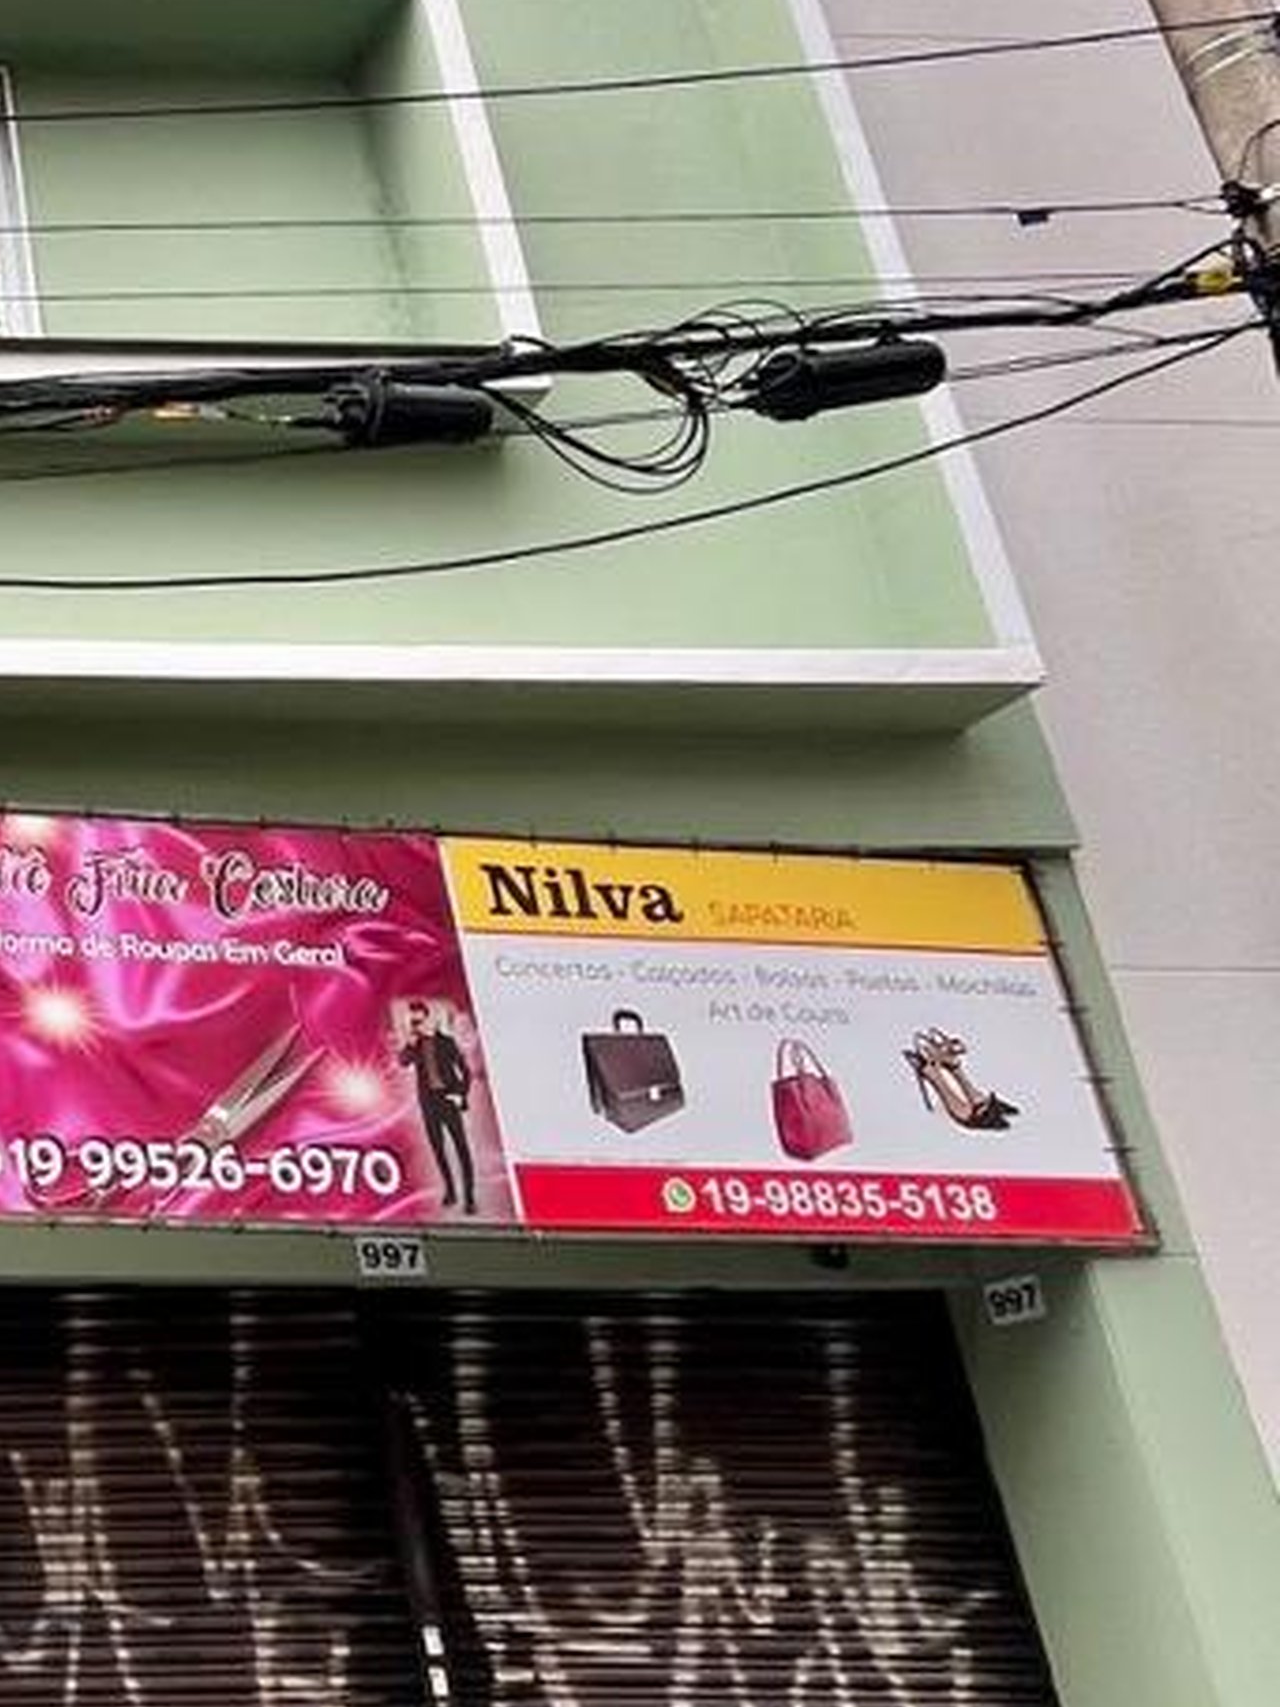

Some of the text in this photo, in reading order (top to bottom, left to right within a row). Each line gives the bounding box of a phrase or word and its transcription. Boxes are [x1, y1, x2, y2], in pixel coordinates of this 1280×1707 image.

[479, 863, 685, 923] Nilva
[81, 932, 116, 958] de
[122, 935, 221, 965] Roupas
[225, 939, 270, 965] Em
[274, 940, 344, 968] Geral
[701, 1177, 997, 1220] 19-98835-5138
[361, 1242, 419, 1270] 997
[988, 1282, 1037, 1318] 997
